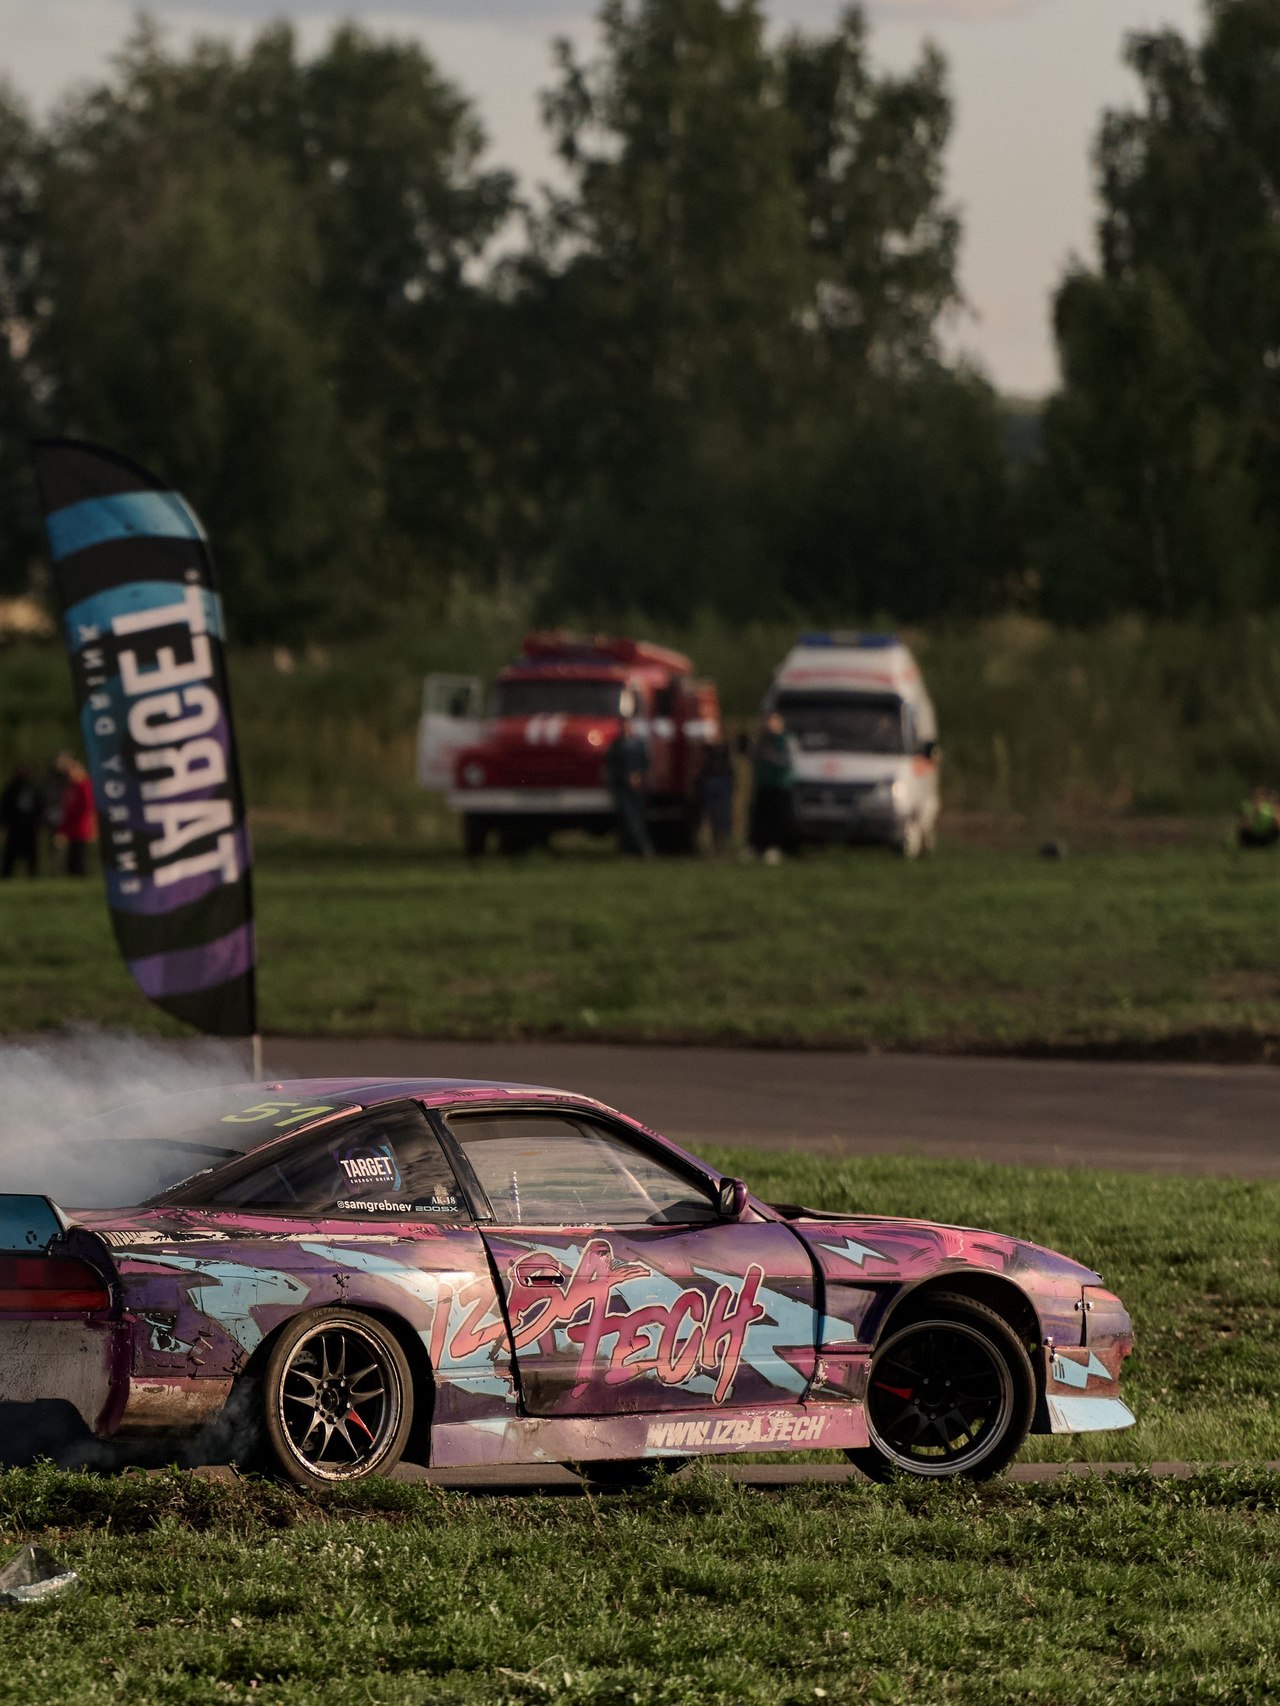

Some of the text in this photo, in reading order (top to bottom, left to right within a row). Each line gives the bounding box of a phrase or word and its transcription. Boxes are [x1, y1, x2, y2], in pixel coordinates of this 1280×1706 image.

[221, 1102, 334, 1127] 51
[340, 1156, 392, 1178] TARGET
[431, 1196, 456, 1205] AK-18
[646, 1414, 826, 1448] WWW.IZBA.TECH
